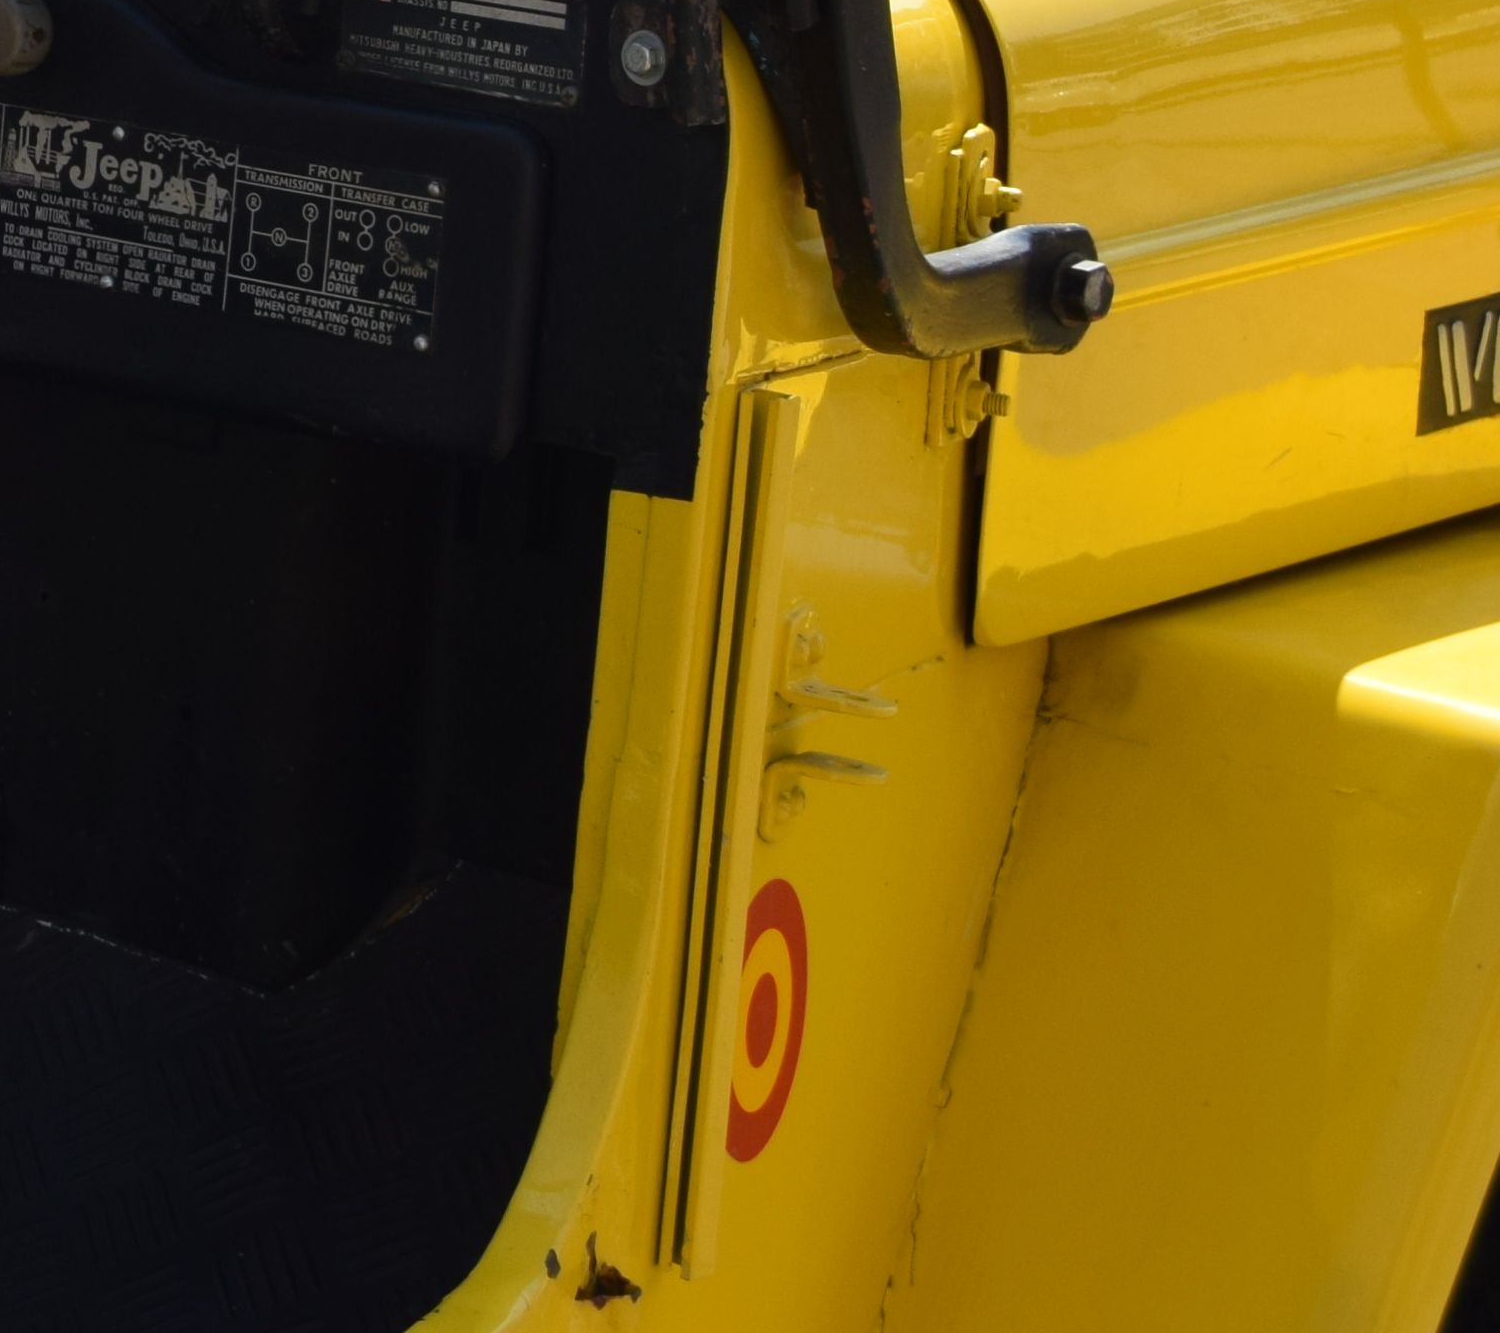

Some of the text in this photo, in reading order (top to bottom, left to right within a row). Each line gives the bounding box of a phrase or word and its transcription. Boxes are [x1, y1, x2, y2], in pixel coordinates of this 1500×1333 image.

[392, 24, 529, 57] MANUFACTURED IN JAPAN BY
[349, 34, 555, 78] MITSUBISHI REORGANIZED
[448, 66, 480, 83] WILLYS
[69, 140, 164, 202] Jeep
[308, 163, 364, 184] FRONT
[245, 169, 430, 214] TRANSMISSION TRANSFER CASE
[0, 198, 30, 219] WILLYS
[16, 188, 213, 234] ONE QUARTER TON FOUR WHEEL DRIVE
[334, 208, 430, 235] OUT LOW
[4, 221, 216, 272] TO DRAIN COOLING SYSTEM OPEN RADIATOR DRAIN
[338, 231, 349, 243] IN
[2, 245, 212, 296] RADIATOR AND BLOCK DRAIN COCK
[3, 233, 24, 247] COCK
[31, 239, 68, 256] LOCATED
[76, 247, 88, 259] ON
[155, 262, 166, 274] AT
[174, 266, 195, 280] REAR
[204, 272, 215, 283] OF
[329, 259, 365, 275] FRONT
[401, 265, 429, 280] HIGH
[13, 260, 25, 271] ON
[60, 268, 99, 285] FORWARD
[152, 286, 164, 298] OF
[172, 290, 200, 307] ENGINE
[327, 283, 359, 298] DRIVE
[328, 271, 357, 285] AXLE
[240, 283, 412, 325] DISENGAGE FRONT AXLE DRIVE
[378, 288, 417, 307] RANGE
[254, 298, 368, 329] WHEN OPERATING ON
[354, 328, 392, 346] ROADS
